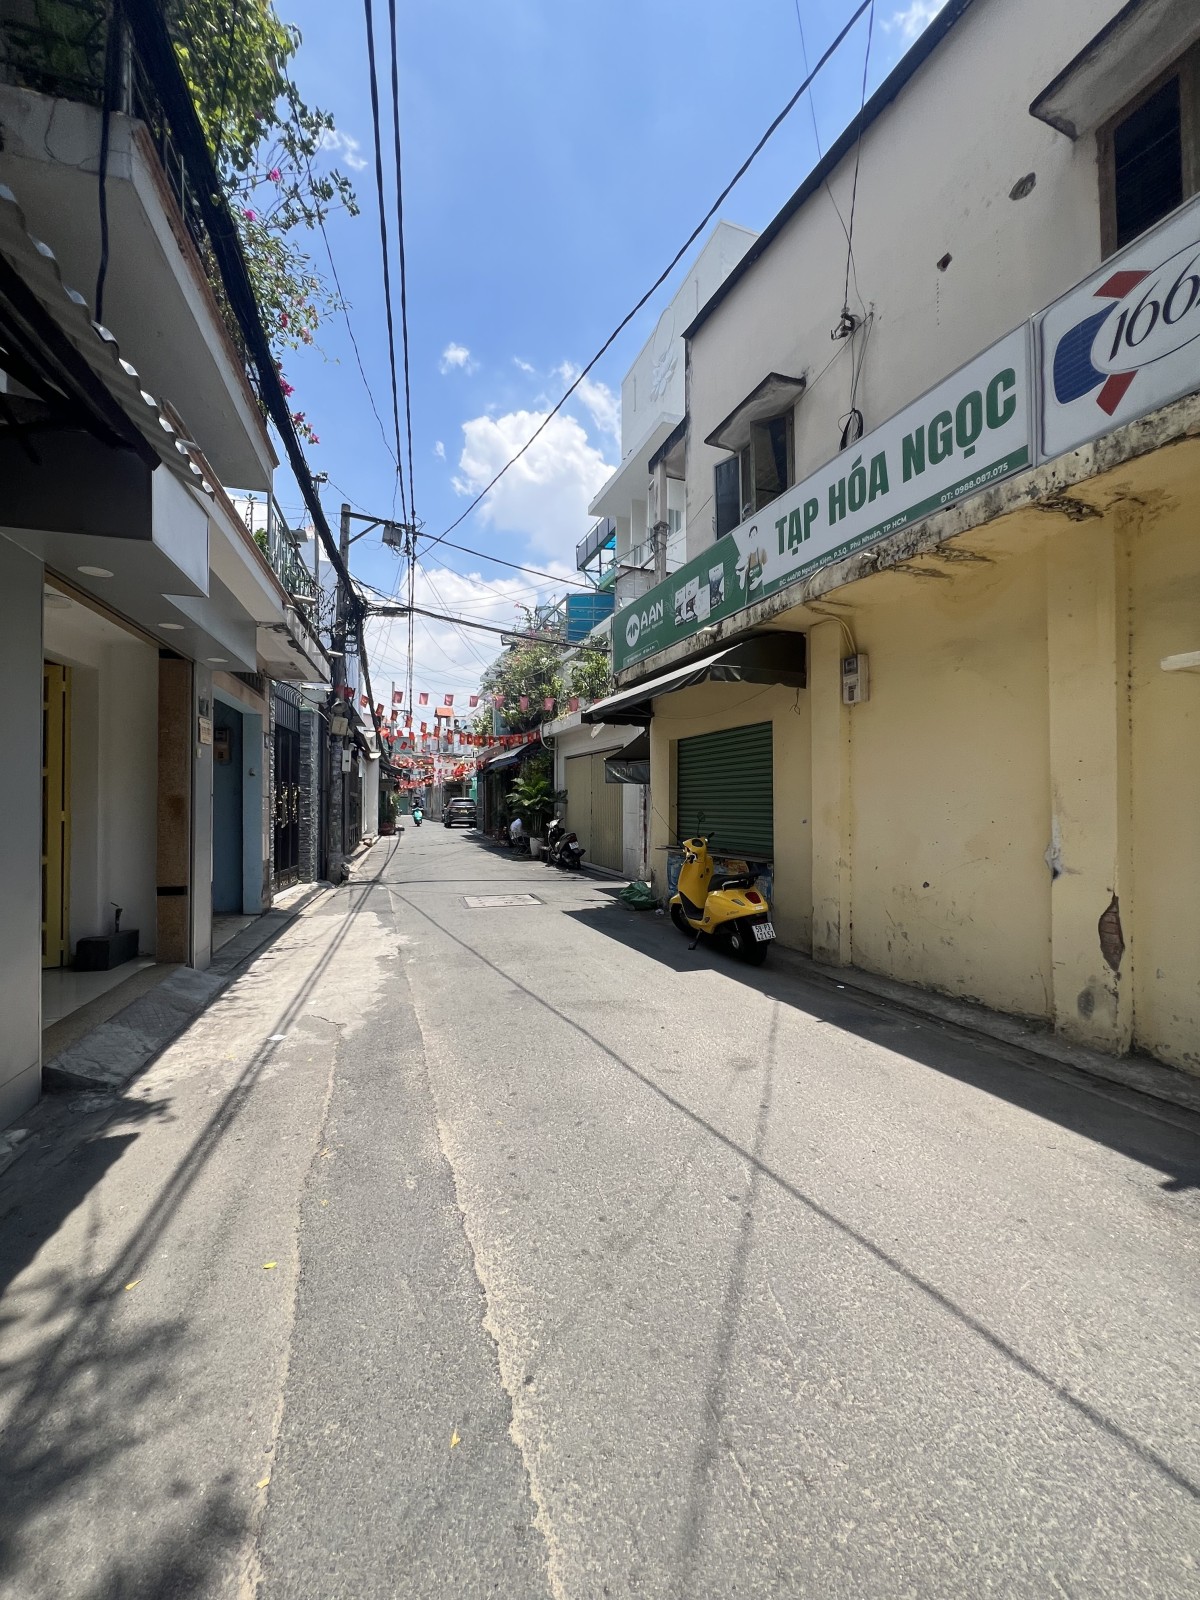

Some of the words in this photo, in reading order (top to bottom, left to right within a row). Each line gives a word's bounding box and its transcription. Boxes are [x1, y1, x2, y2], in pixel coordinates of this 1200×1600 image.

[1108, 253, 1200, 362] 166
[775, 498, 819, 556] TẠP
[829, 451, 890, 526] HÓA
[902, 368, 1017, 483] NGỌC
[941, 492, 954, 503] ĐT:
[954, 462, 1009, 496] 0988.087.075
[883, 523, 891, 533] TP
[892, 515, 907, 529] HCM
[640, 599, 664, 630] AAN
